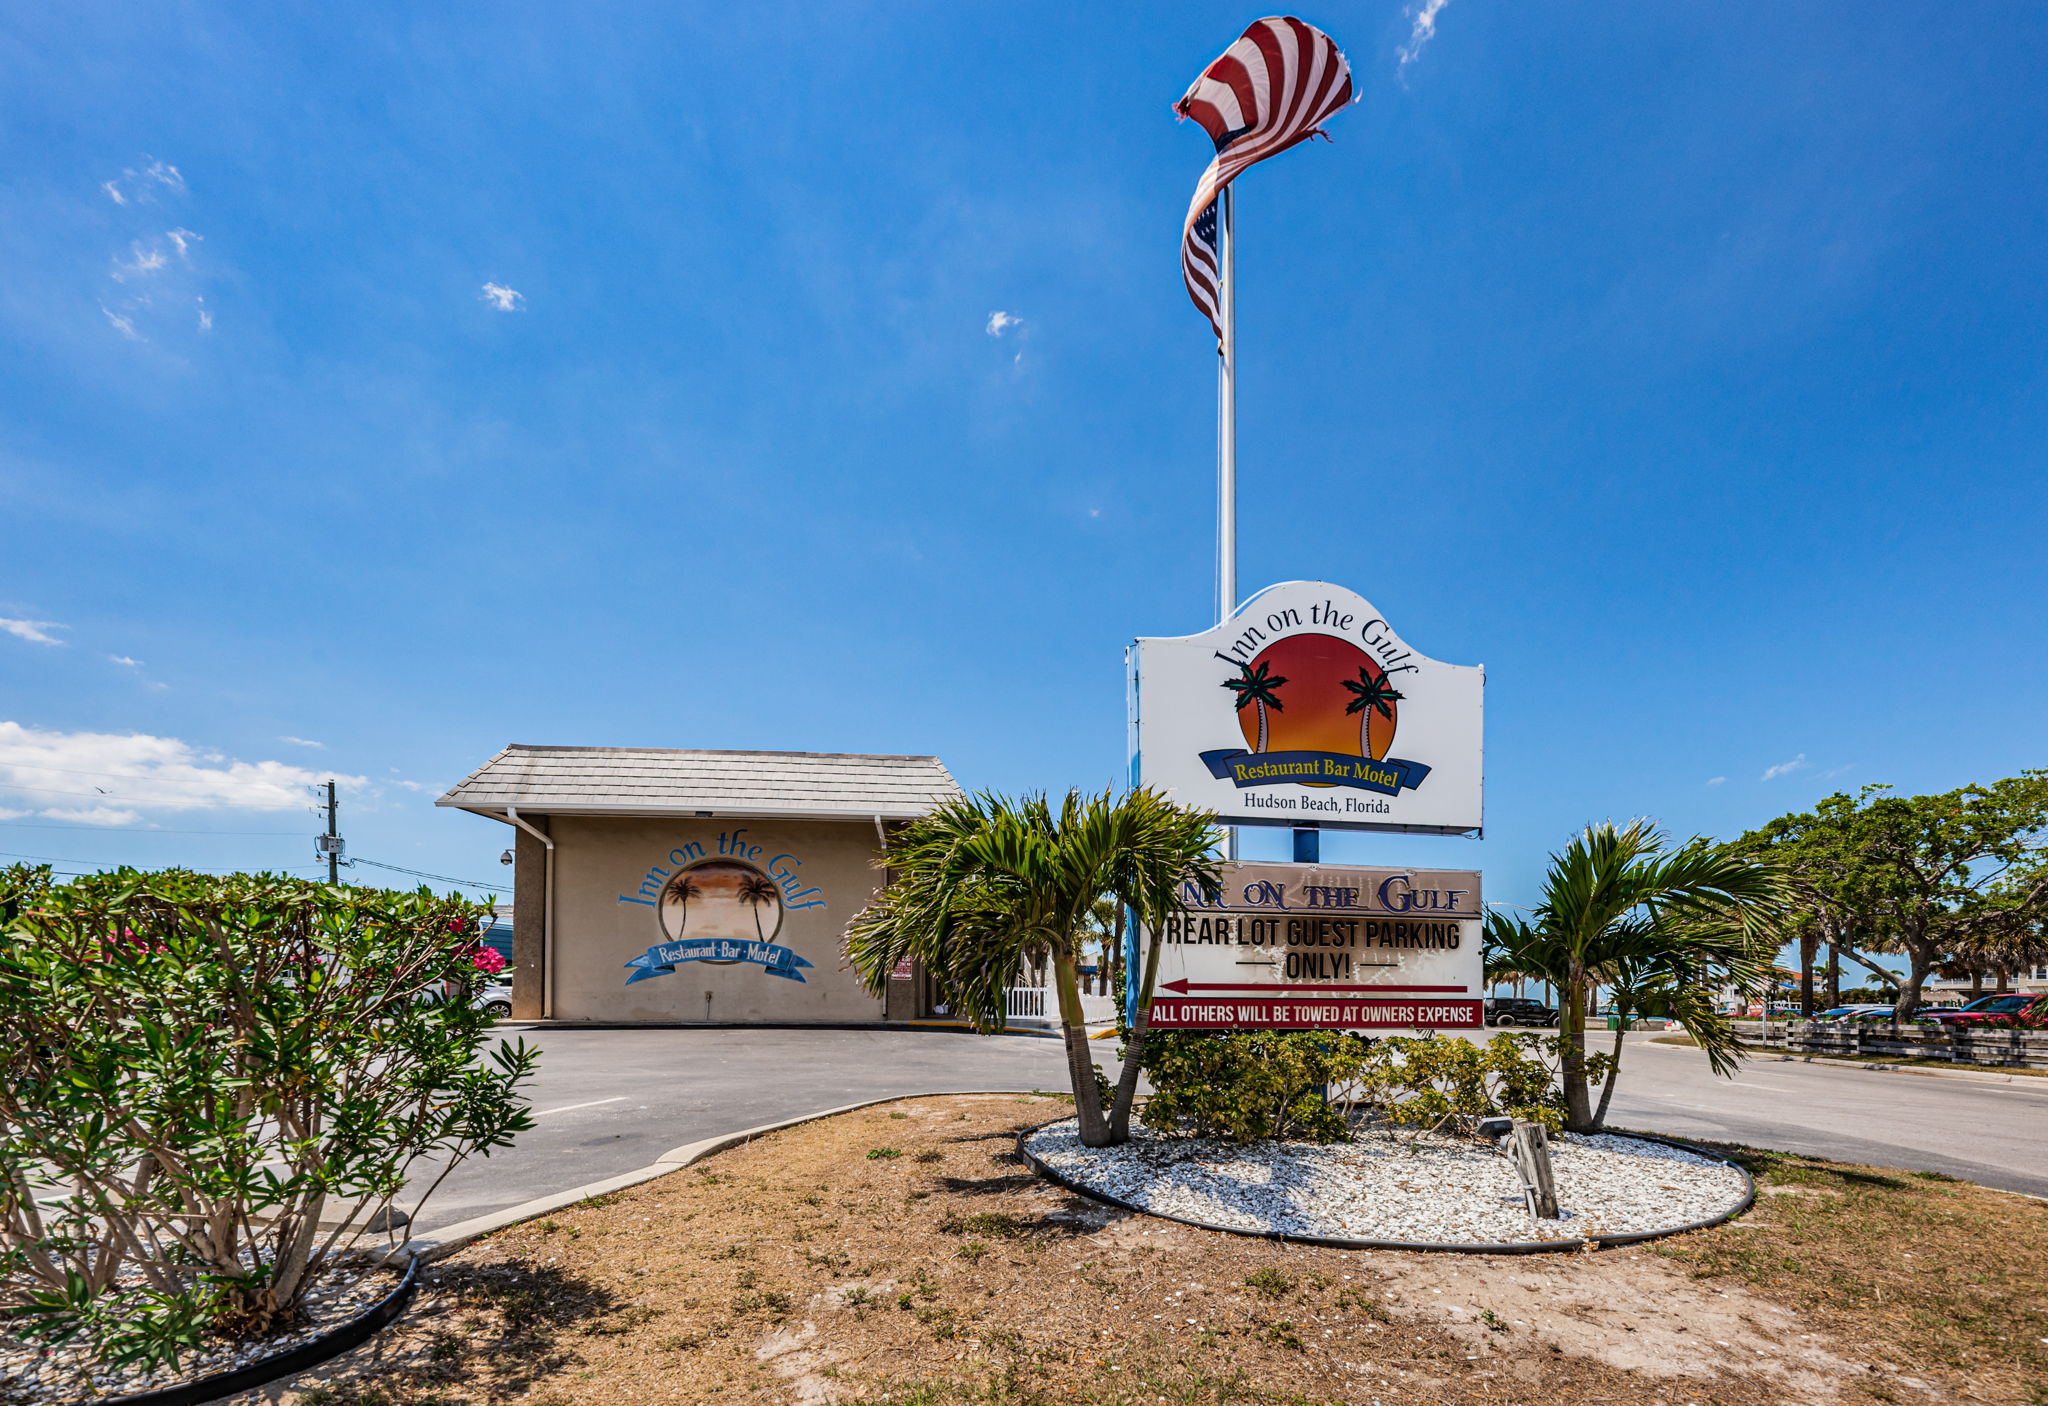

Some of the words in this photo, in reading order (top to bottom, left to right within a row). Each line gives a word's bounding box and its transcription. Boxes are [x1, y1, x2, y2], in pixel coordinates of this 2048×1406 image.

[1214, 625, 1266, 666] Inn
[1266, 608, 1302, 632] on
[1309, 600, 1354, 631] the
[1361, 619, 1419, 675] Gulf
[1235, 761, 1320, 781] Restaurant
[1324, 759, 1350, 777] Bar
[1353, 762, 1398, 788] Motel
[1244, 793, 1297, 810] Hudson
[1301, 795, 1342, 814] Beach,
[1345, 798, 1390, 814] Florida
[617, 865, 671, 909] Inn
[669, 841, 706, 866] on
[717, 829, 763, 861] the
[767, 853, 828, 911] Gulf
[1172, 878, 1230, 909] NN
[1243, 879, 1290, 911] ON
[1304, 885, 1359, 909] THE
[1378, 875, 1469, 914] GULF
[1167, 917, 1230, 945] REAR
[1238, 918, 1281, 946] LOT
[1287, 918, 1361, 948] GUEST
[1366, 922, 1460, 950] PARKING
[658, 942, 716, 963] Restaurant
[721, 942, 741, 958] Bar
[747, 944, 781, 965] Motel
[1286, 952, 1350, 980] ONLY!
[1152, 1006, 1177, 1022] ALL
[1181, 1006, 1234, 1022] OTHERS
[1238, 1006, 1270, 1022] WILL
[1273, 1006, 1290, 1022] BE
[1295, 1006, 1340, 1022] TOWED
[1343, 1006, 1359, 1022] AT
[1361, 1006, 1415, 1022] OWNERS
[1418, 1006, 1474, 1023] EXPENSE
